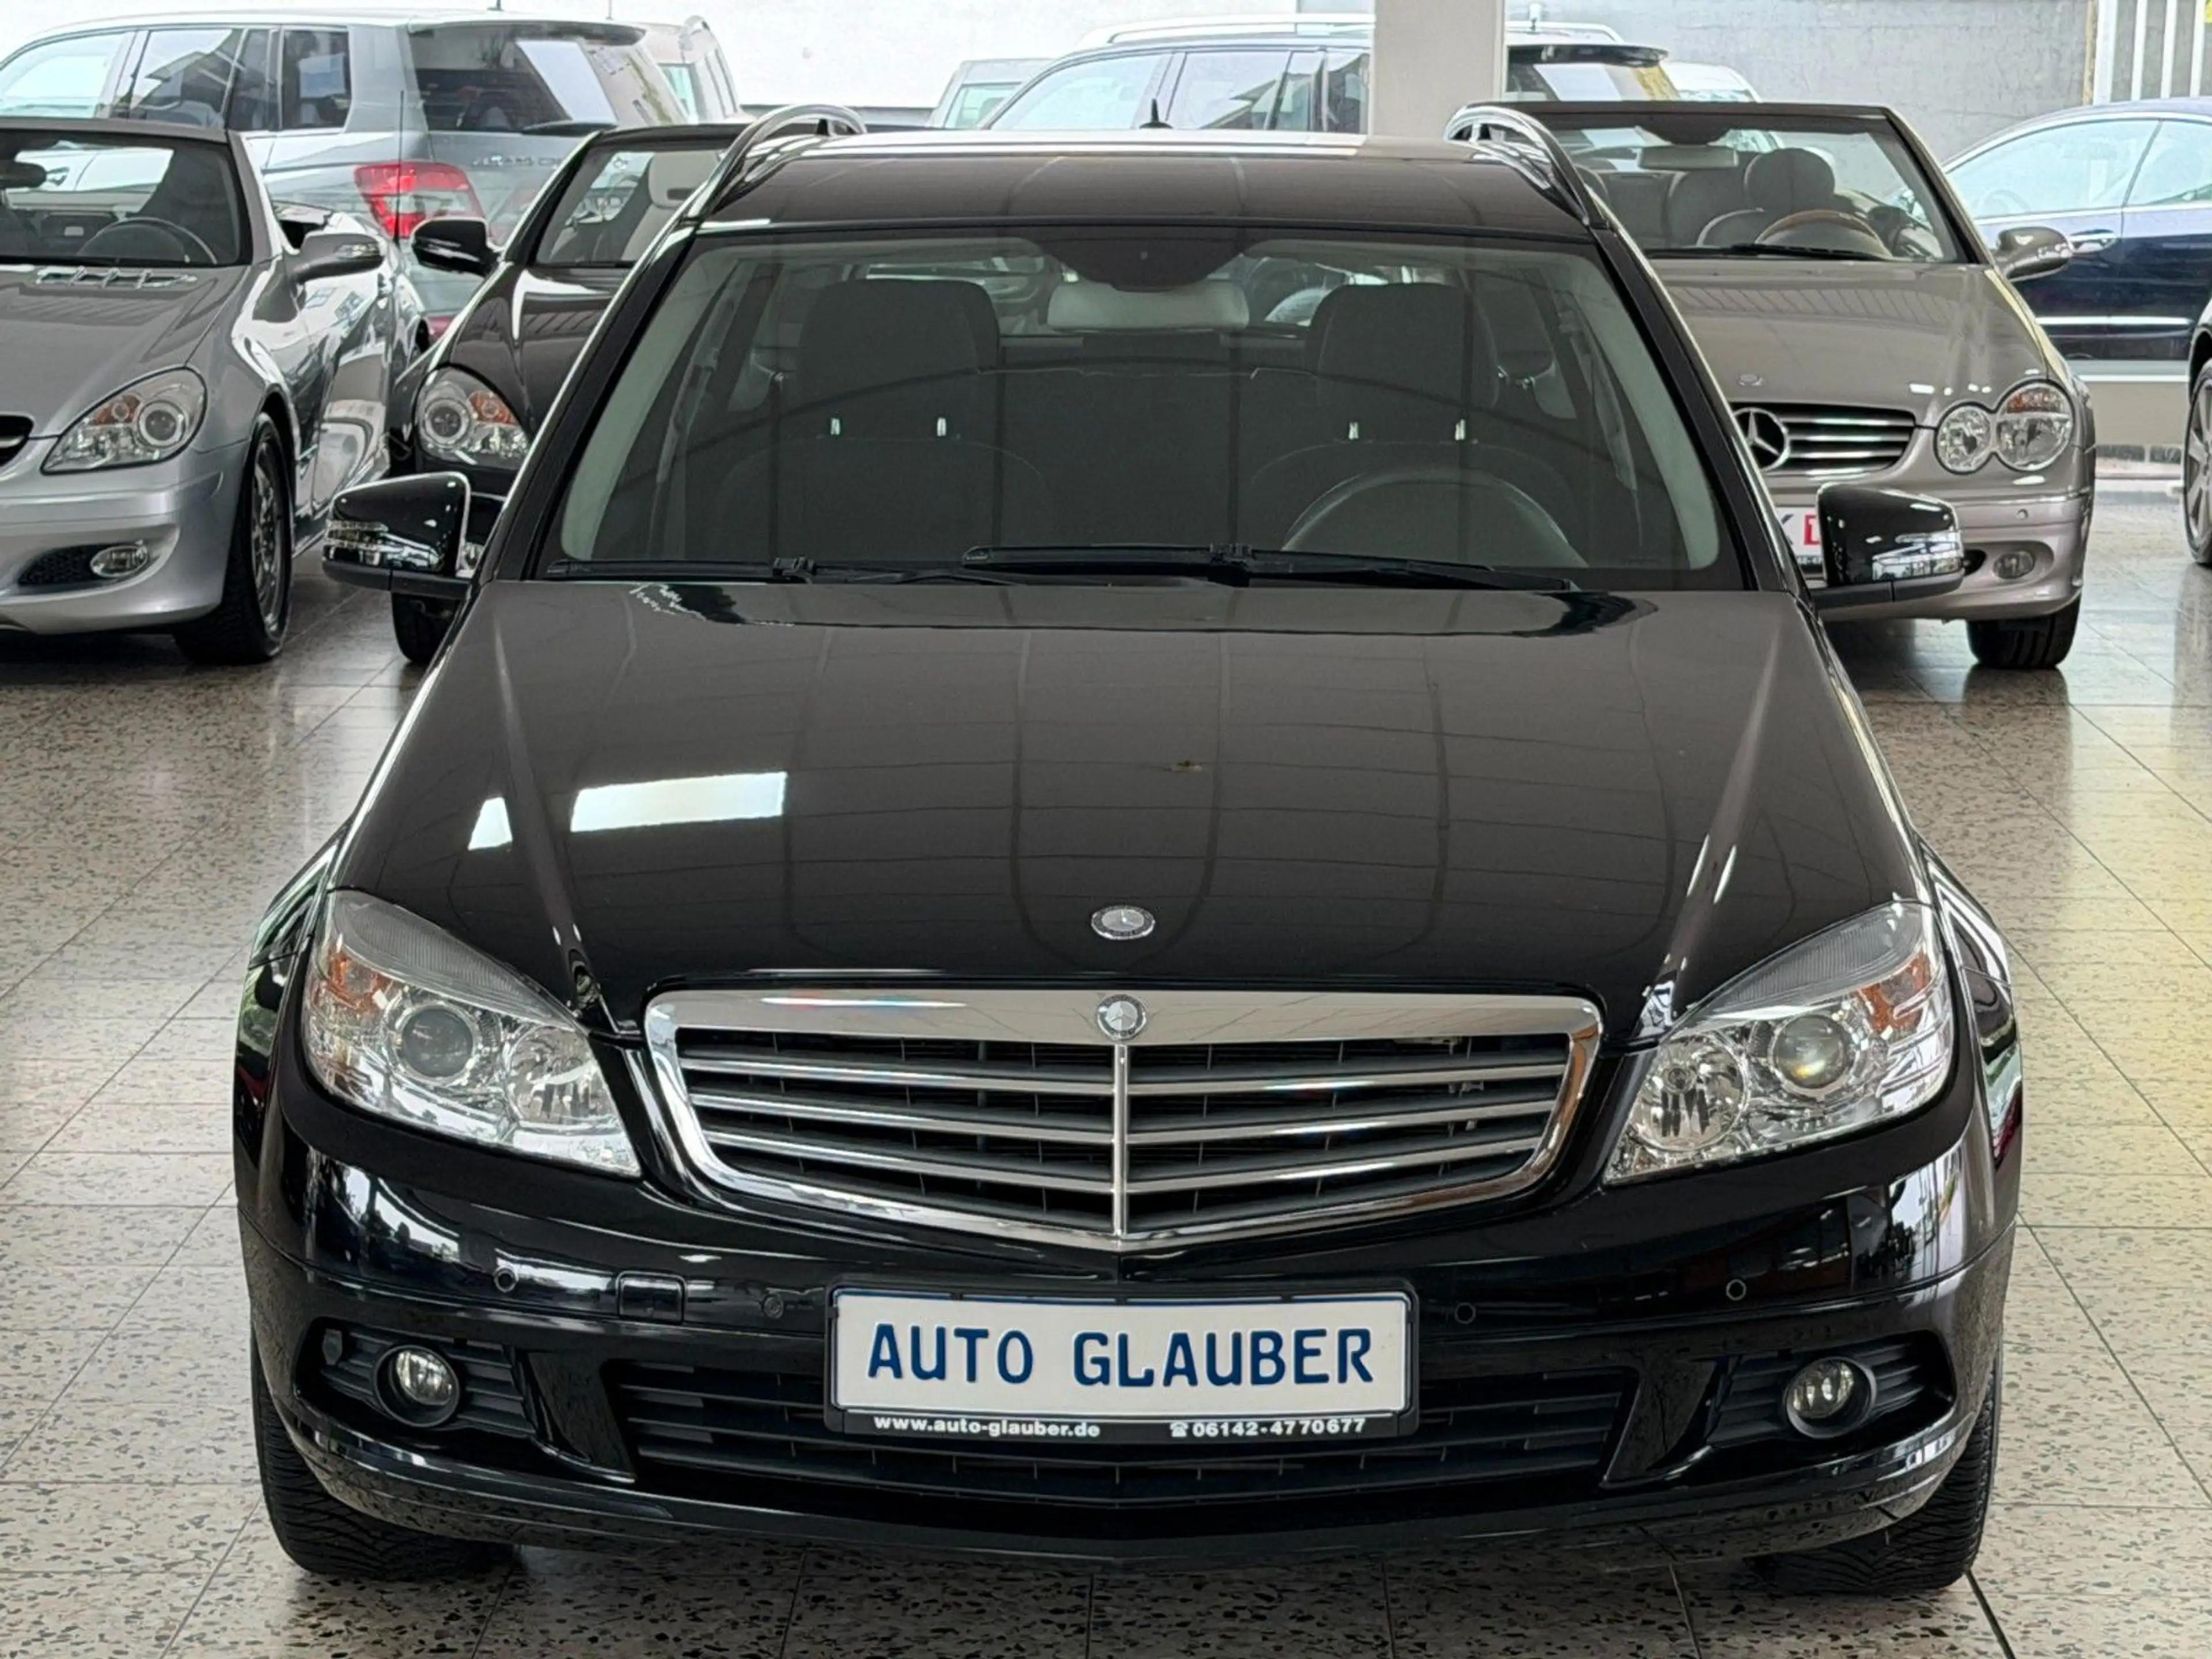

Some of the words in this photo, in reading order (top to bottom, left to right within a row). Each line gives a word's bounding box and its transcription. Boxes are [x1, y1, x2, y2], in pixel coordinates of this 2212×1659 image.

[868, 1323, 1033, 1384] AUTO
[1073, 1328, 1374, 1387] GLAUBER
[874, 1416, 1100, 1437] www.auto-glauber.de
